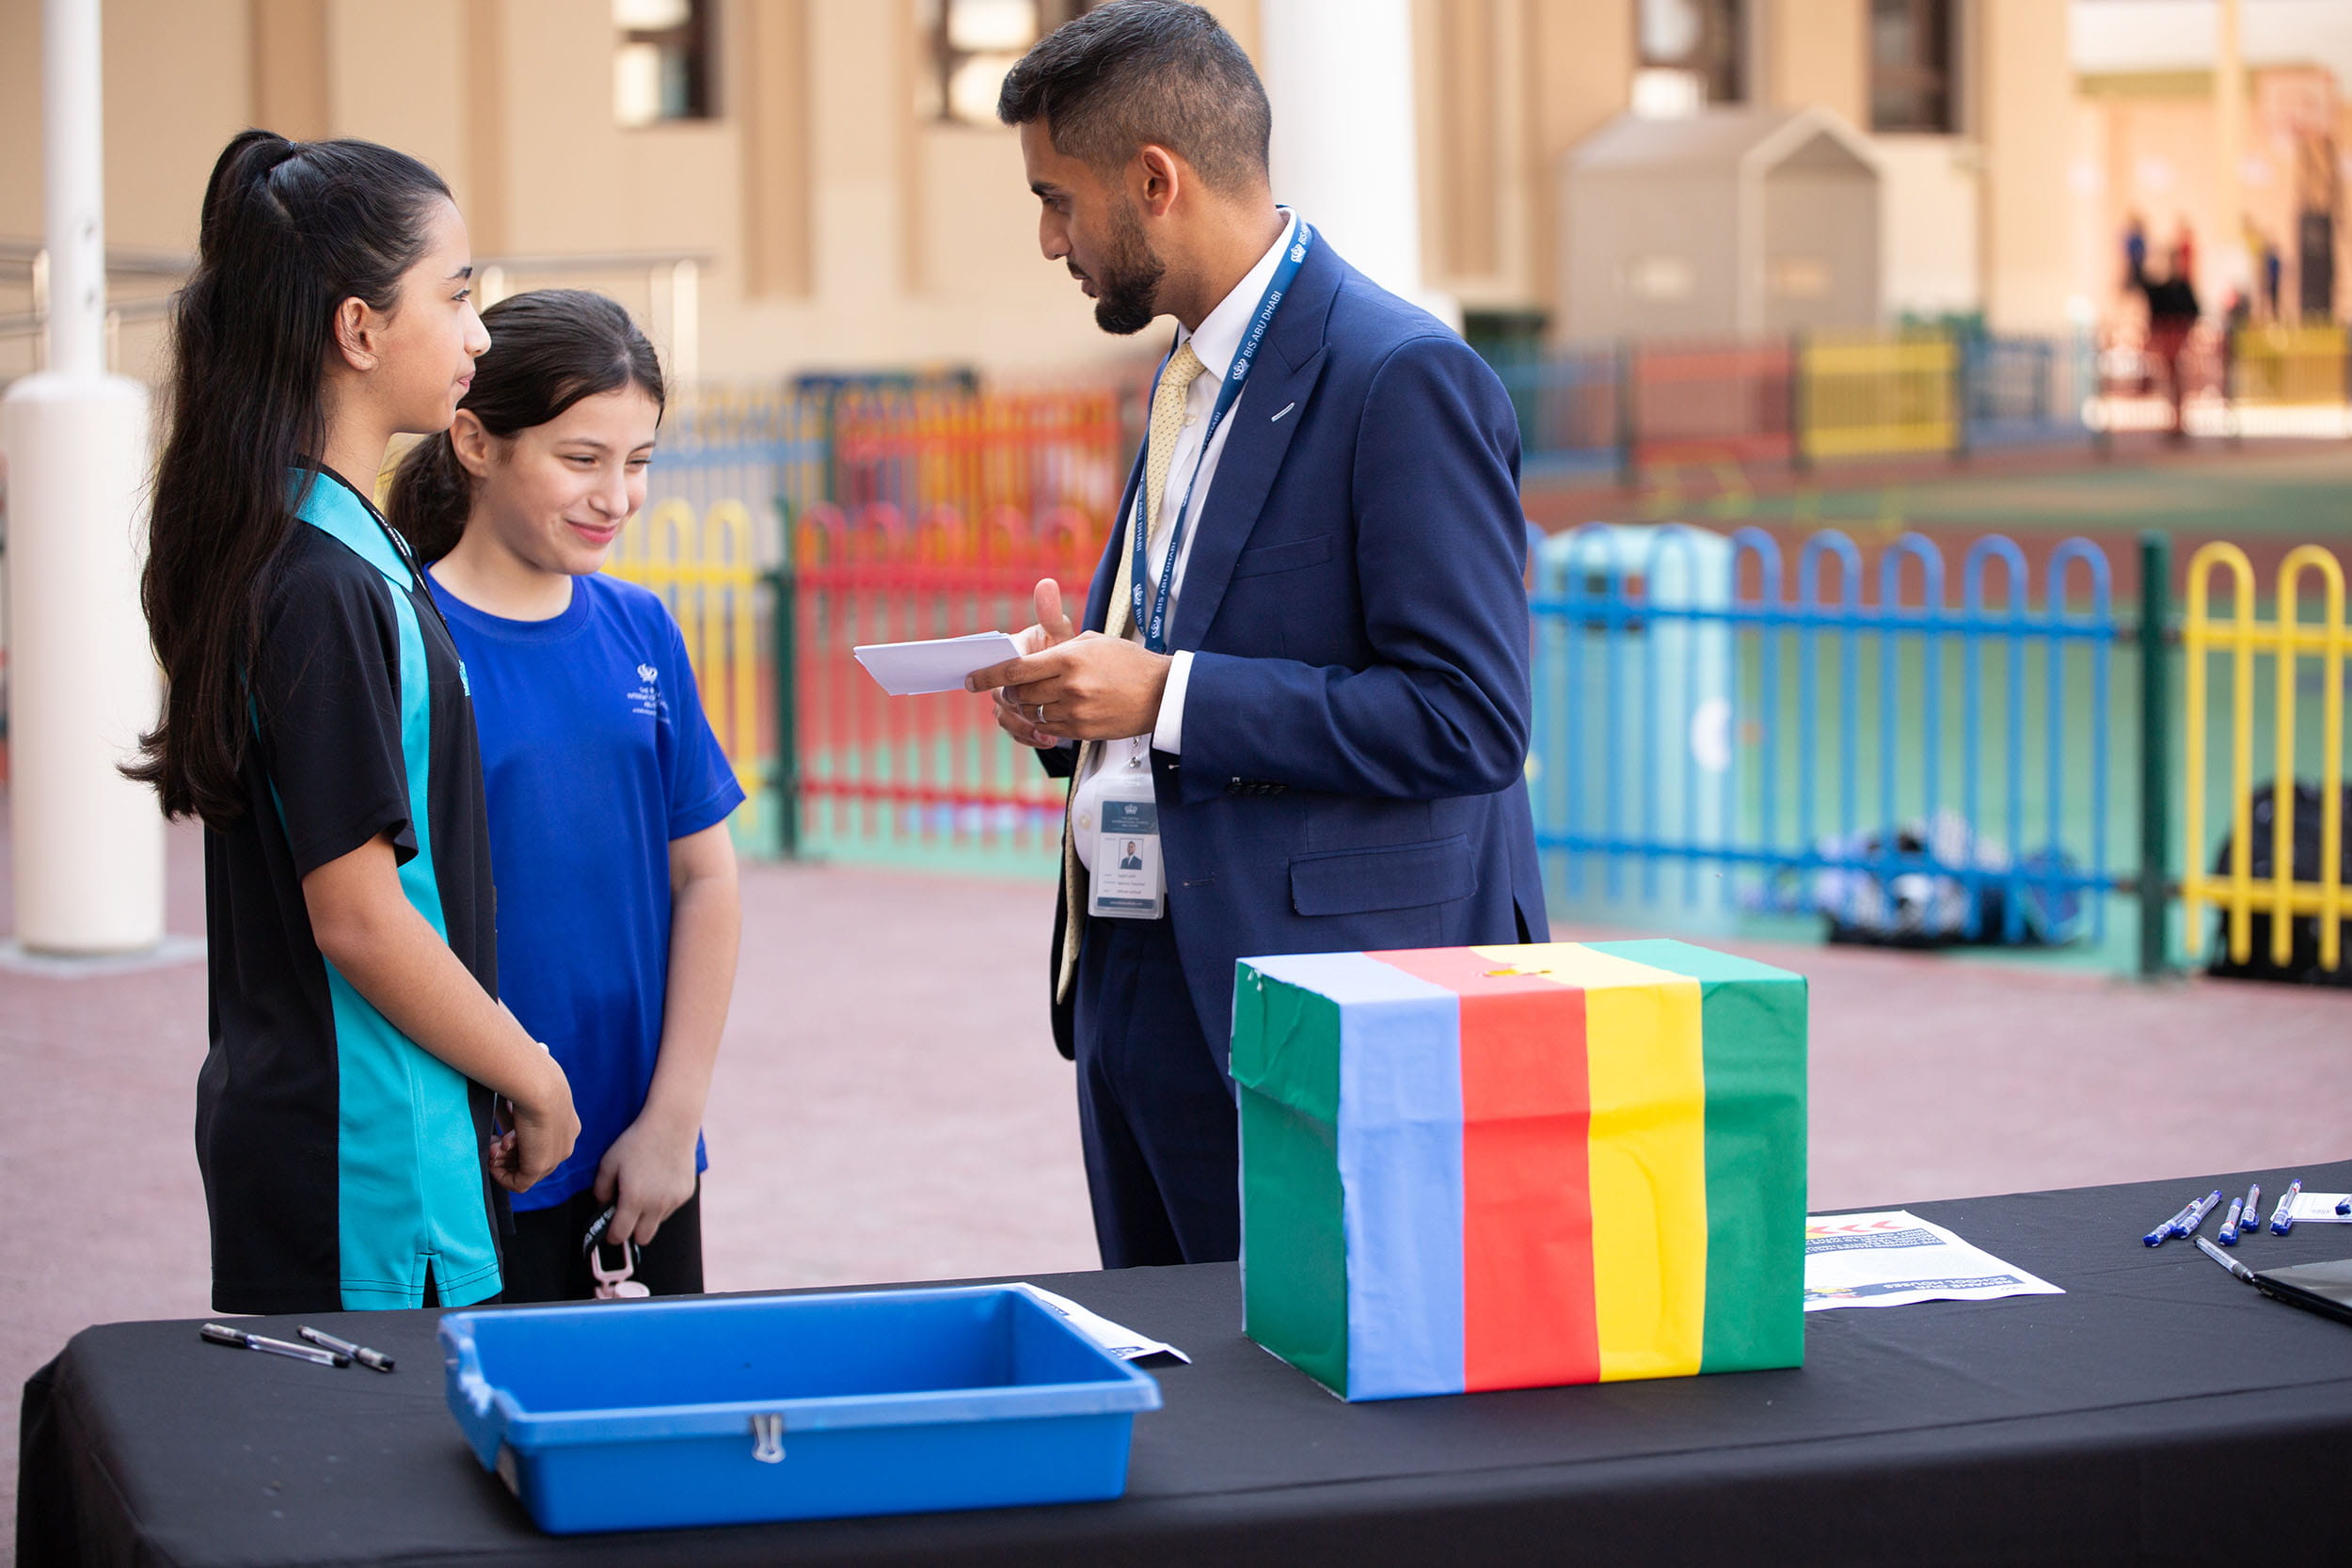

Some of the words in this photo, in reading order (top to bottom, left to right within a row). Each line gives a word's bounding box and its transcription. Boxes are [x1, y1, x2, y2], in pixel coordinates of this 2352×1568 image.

[1243, 341, 1258, 357] BIS
[1251, 320, 1267, 341] ABU
[1261, 291, 1282, 321] DHABI
[1155, 596, 1165, 613] BIS
[1160, 574, 1168, 595] ABU
[1165, 542, 1176, 572] DHABI
